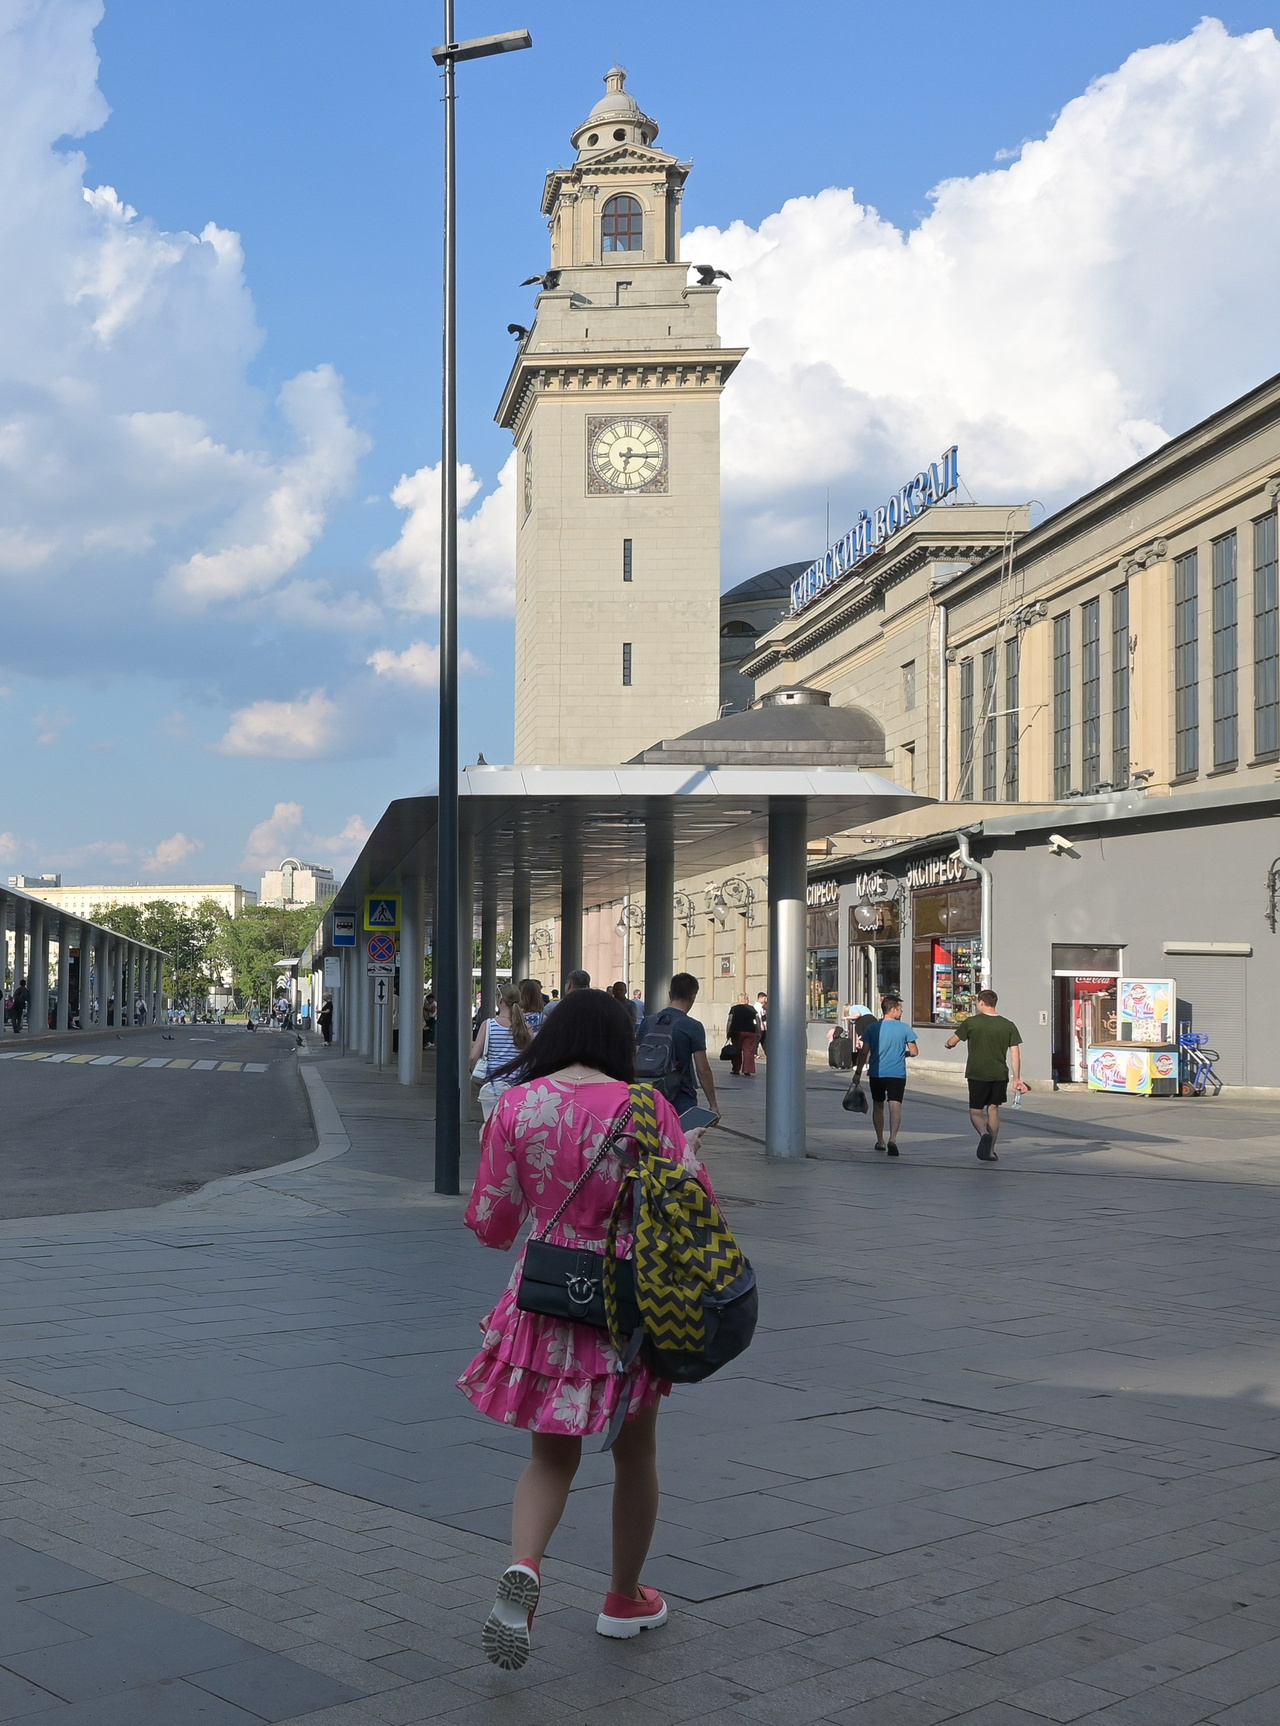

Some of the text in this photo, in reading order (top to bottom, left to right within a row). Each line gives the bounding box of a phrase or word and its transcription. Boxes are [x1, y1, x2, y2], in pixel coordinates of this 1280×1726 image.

[790, 445, 958, 609] КИЕВСКИЙ ВОКЗАЛ
[855, 870, 886, 897] КАФЕ
[905, 854, 963, 886] ЭКСПРЕСС
[807, 879, 838, 906] СПРЕСС
